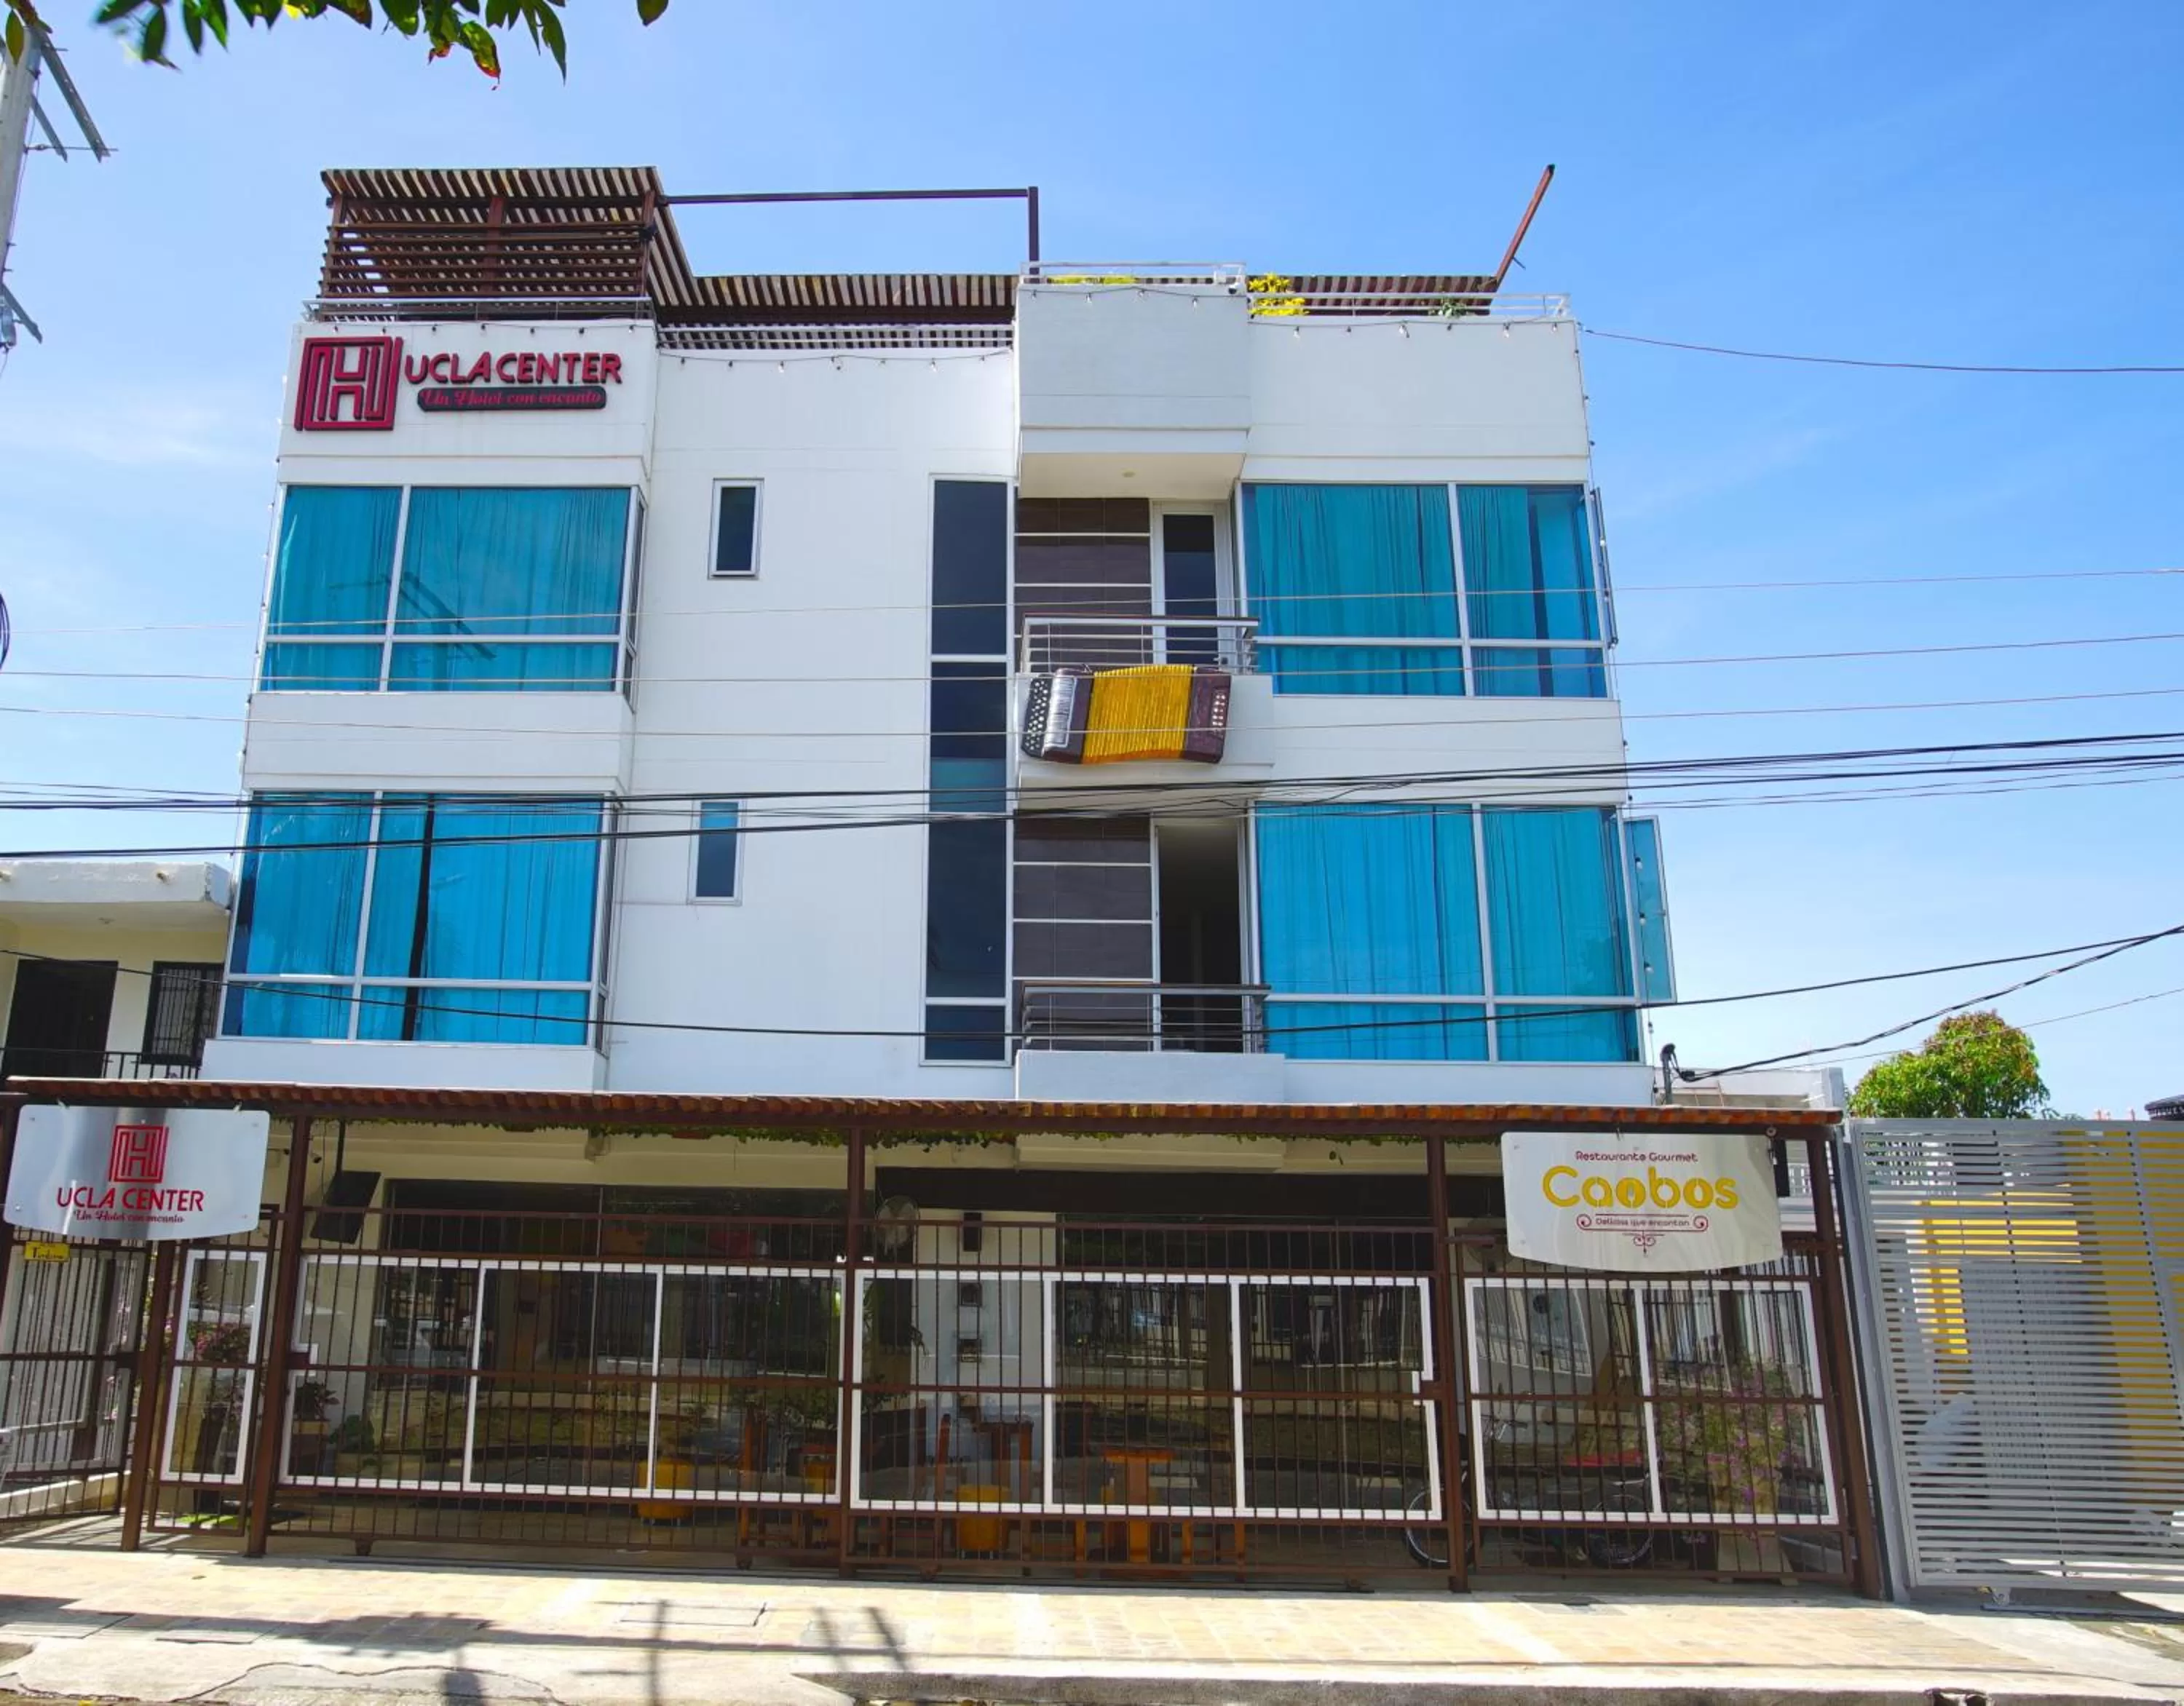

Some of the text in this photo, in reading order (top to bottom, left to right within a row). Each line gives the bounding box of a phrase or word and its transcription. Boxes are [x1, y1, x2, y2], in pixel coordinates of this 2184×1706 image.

[454, 389, 502, 406] Hotel
[507, 393, 536, 405] con
[539, 390, 601, 405] encanto
[1575, 1150, 1698, 1162] Restaurante Gourmet
[1542, 1166, 1739, 1210] Caobos
[57, 1187, 205, 1211] UCLA CENTER
[74, 1210, 185, 1223] Un Hotel con encanto
[1630, 1219, 1646, 1227] que
